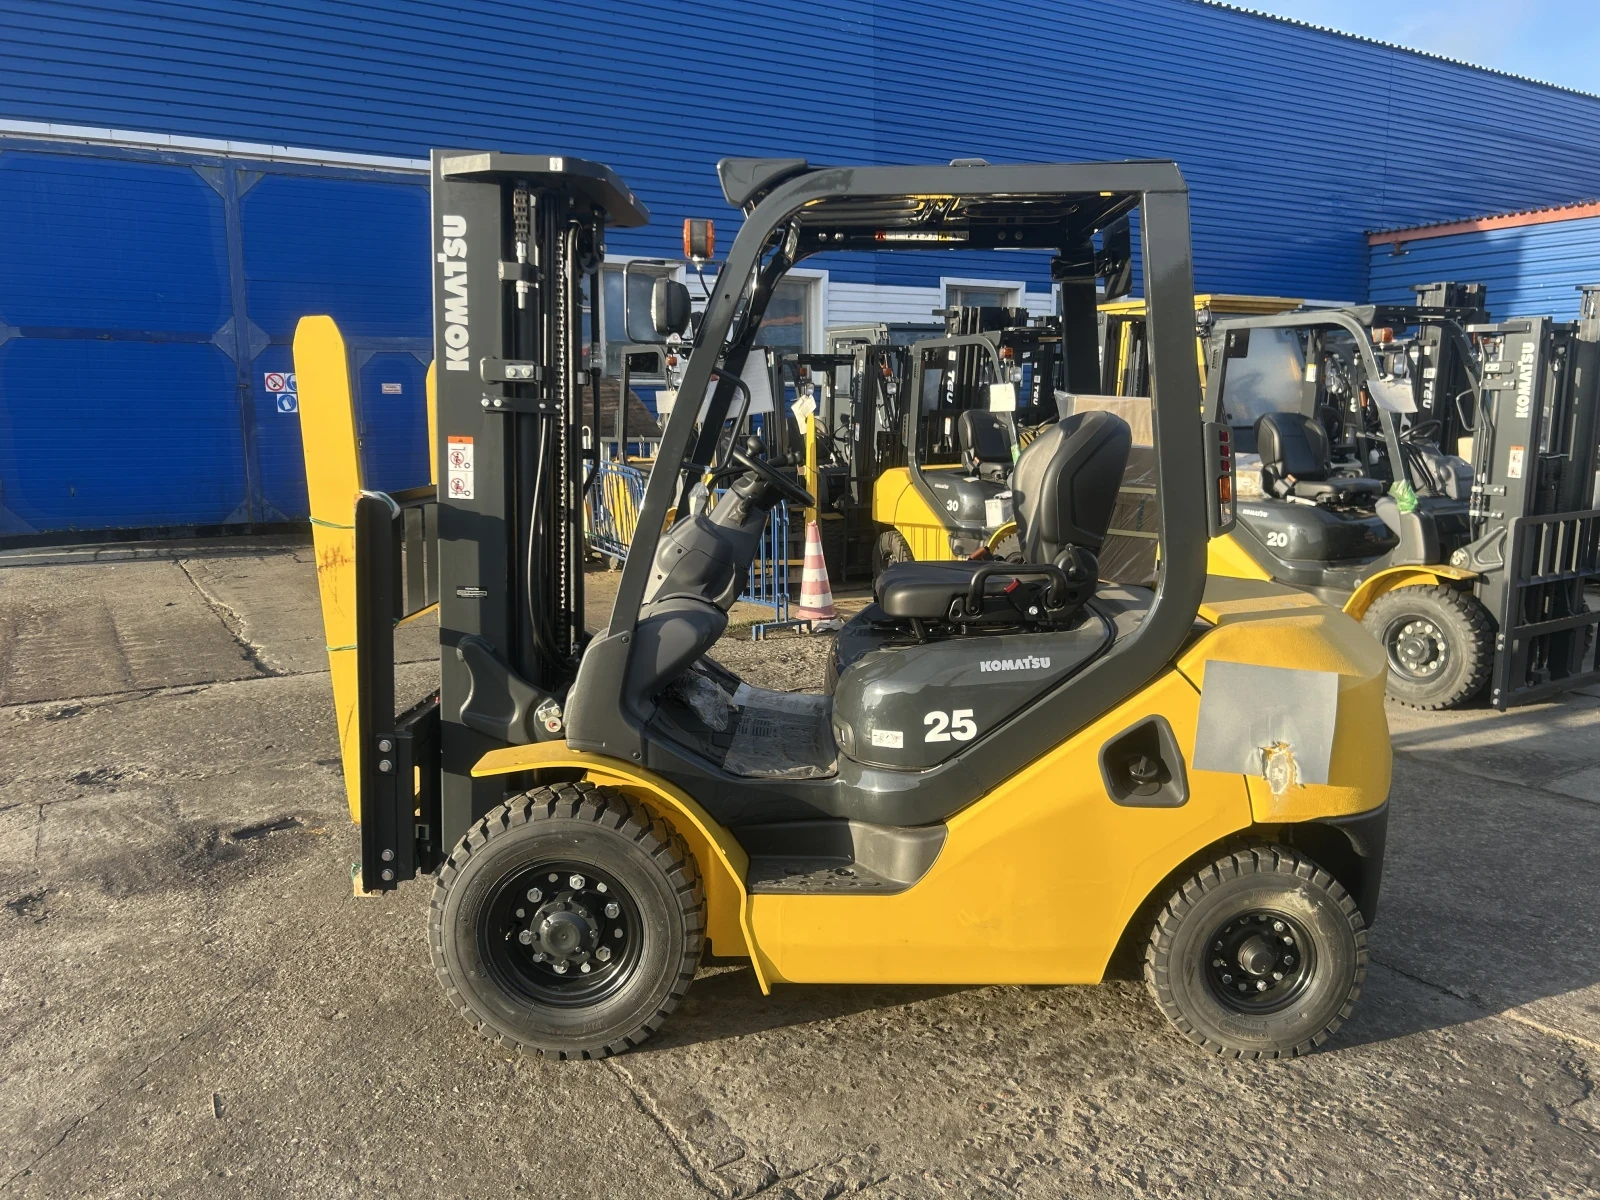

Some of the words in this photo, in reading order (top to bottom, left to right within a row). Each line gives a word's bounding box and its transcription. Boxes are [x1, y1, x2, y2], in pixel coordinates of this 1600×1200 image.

[437, 215, 470, 371] KOMATSU
[946, 370, 956, 404] TEU
[1515, 342, 1535, 419] KOMATSU
[1032, 385, 1040, 406] TEU
[1422, 381, 1433, 409] TEU
[946, 499, 959, 512] 30
[1266, 531, 1288, 548] 20
[980, 655, 1051, 673] KOMATSU
[923, 708, 978, 743] 25
